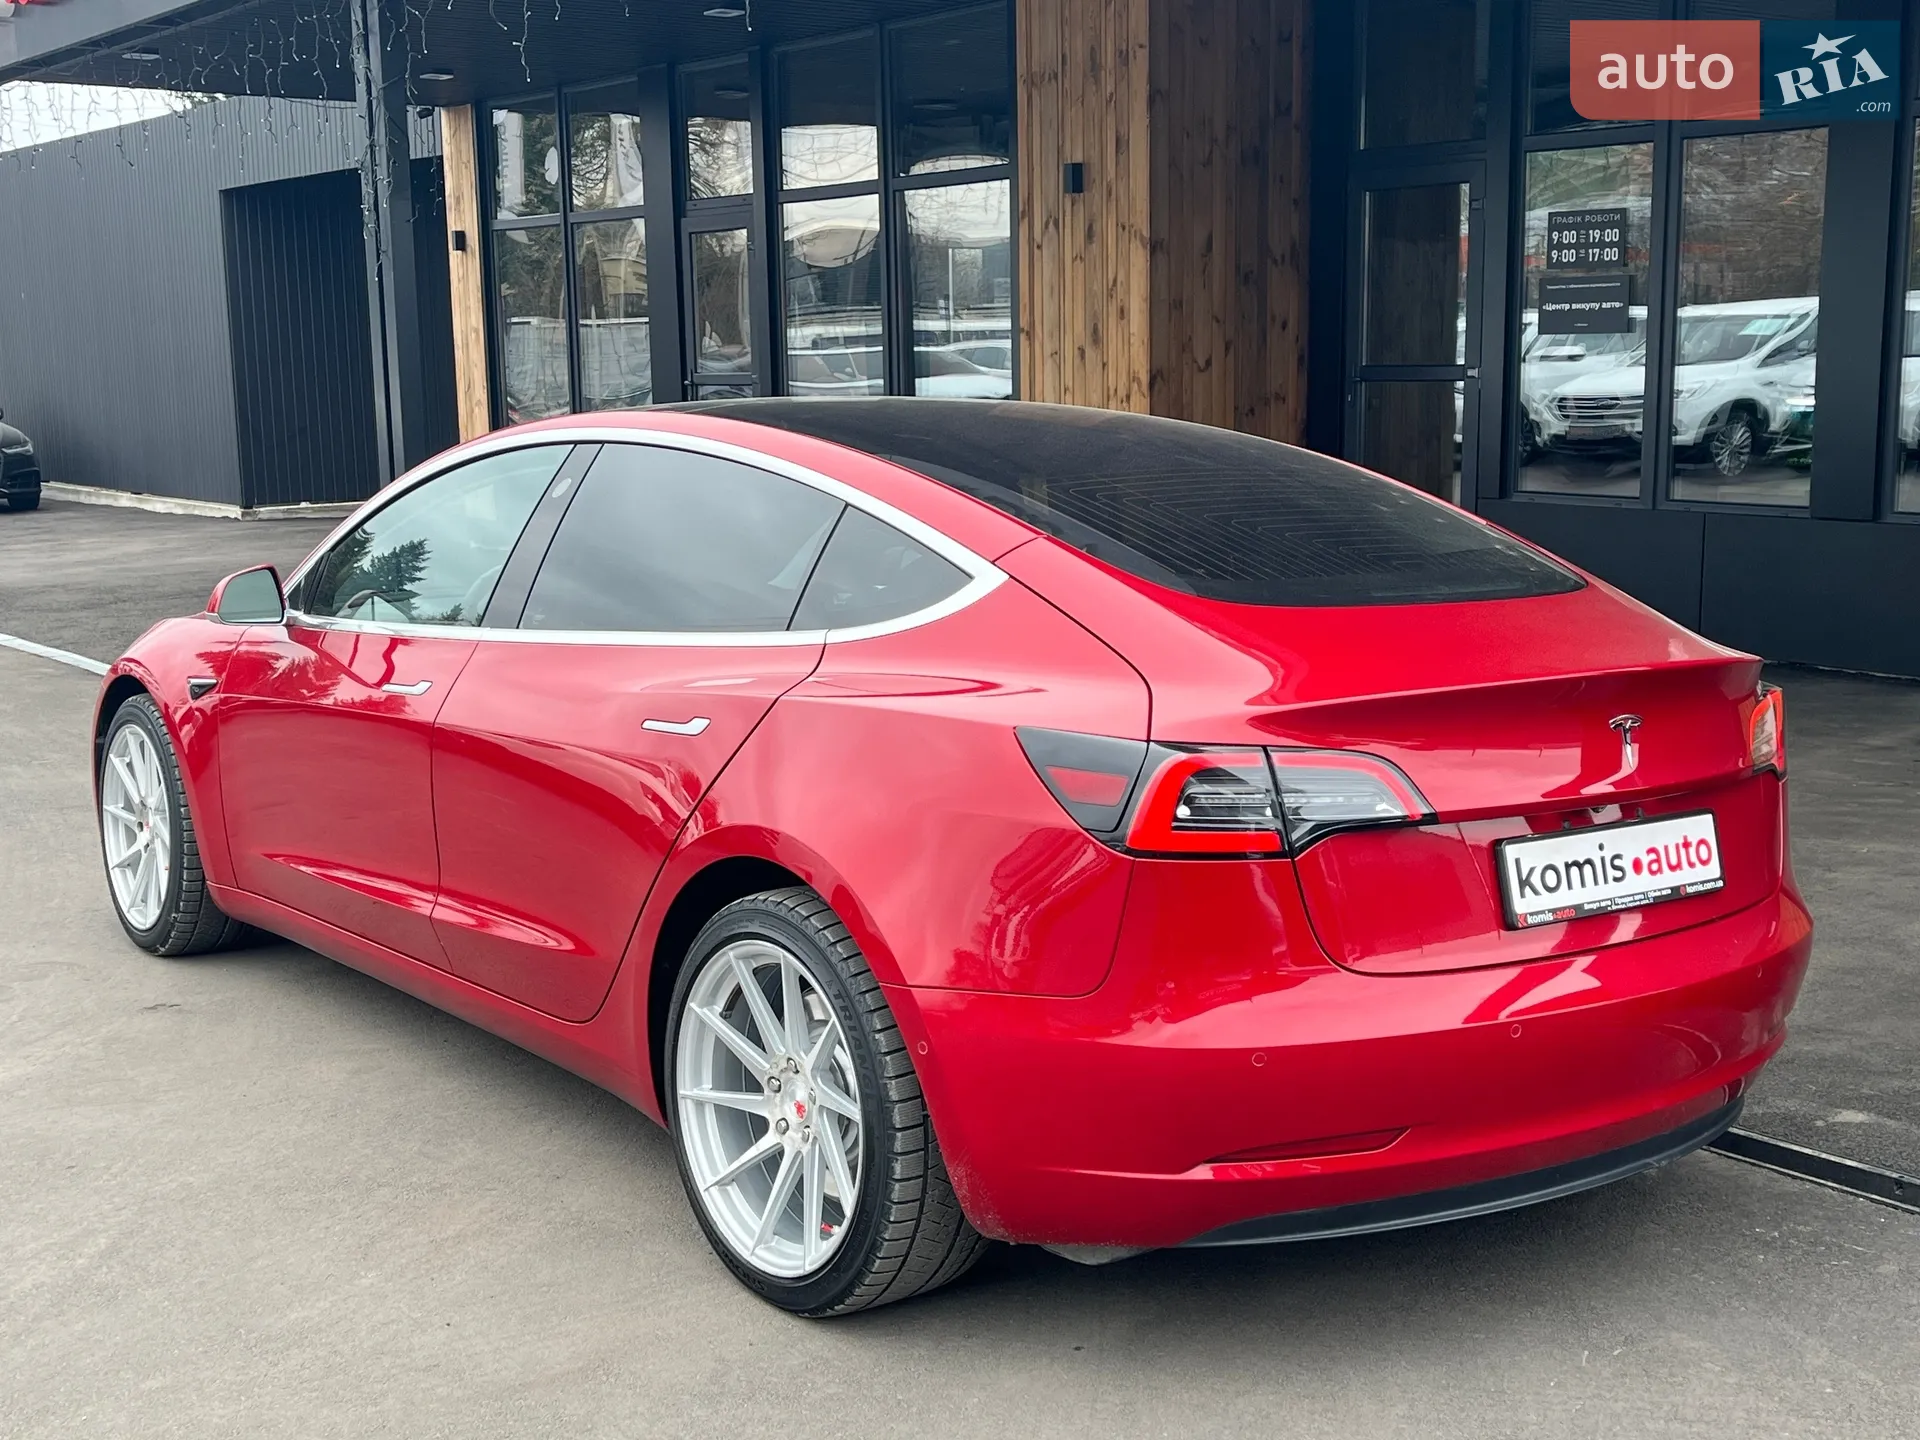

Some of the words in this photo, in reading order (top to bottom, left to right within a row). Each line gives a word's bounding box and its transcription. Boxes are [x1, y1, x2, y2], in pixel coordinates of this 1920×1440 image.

[1552, 216, 1583, 225] ГРАФІК
[1585, 213, 1621, 223] РОБОТИ
[1552, 230, 1577, 244] 9:00
[1588, 228, 1620, 243] 19:00
[1551, 249, 1577, 263] 9:00
[1588, 247, 1619, 262] 17:00
[1514, 842, 1627, 899] komis
[832, 988, 878, 1114] TRIANGL
